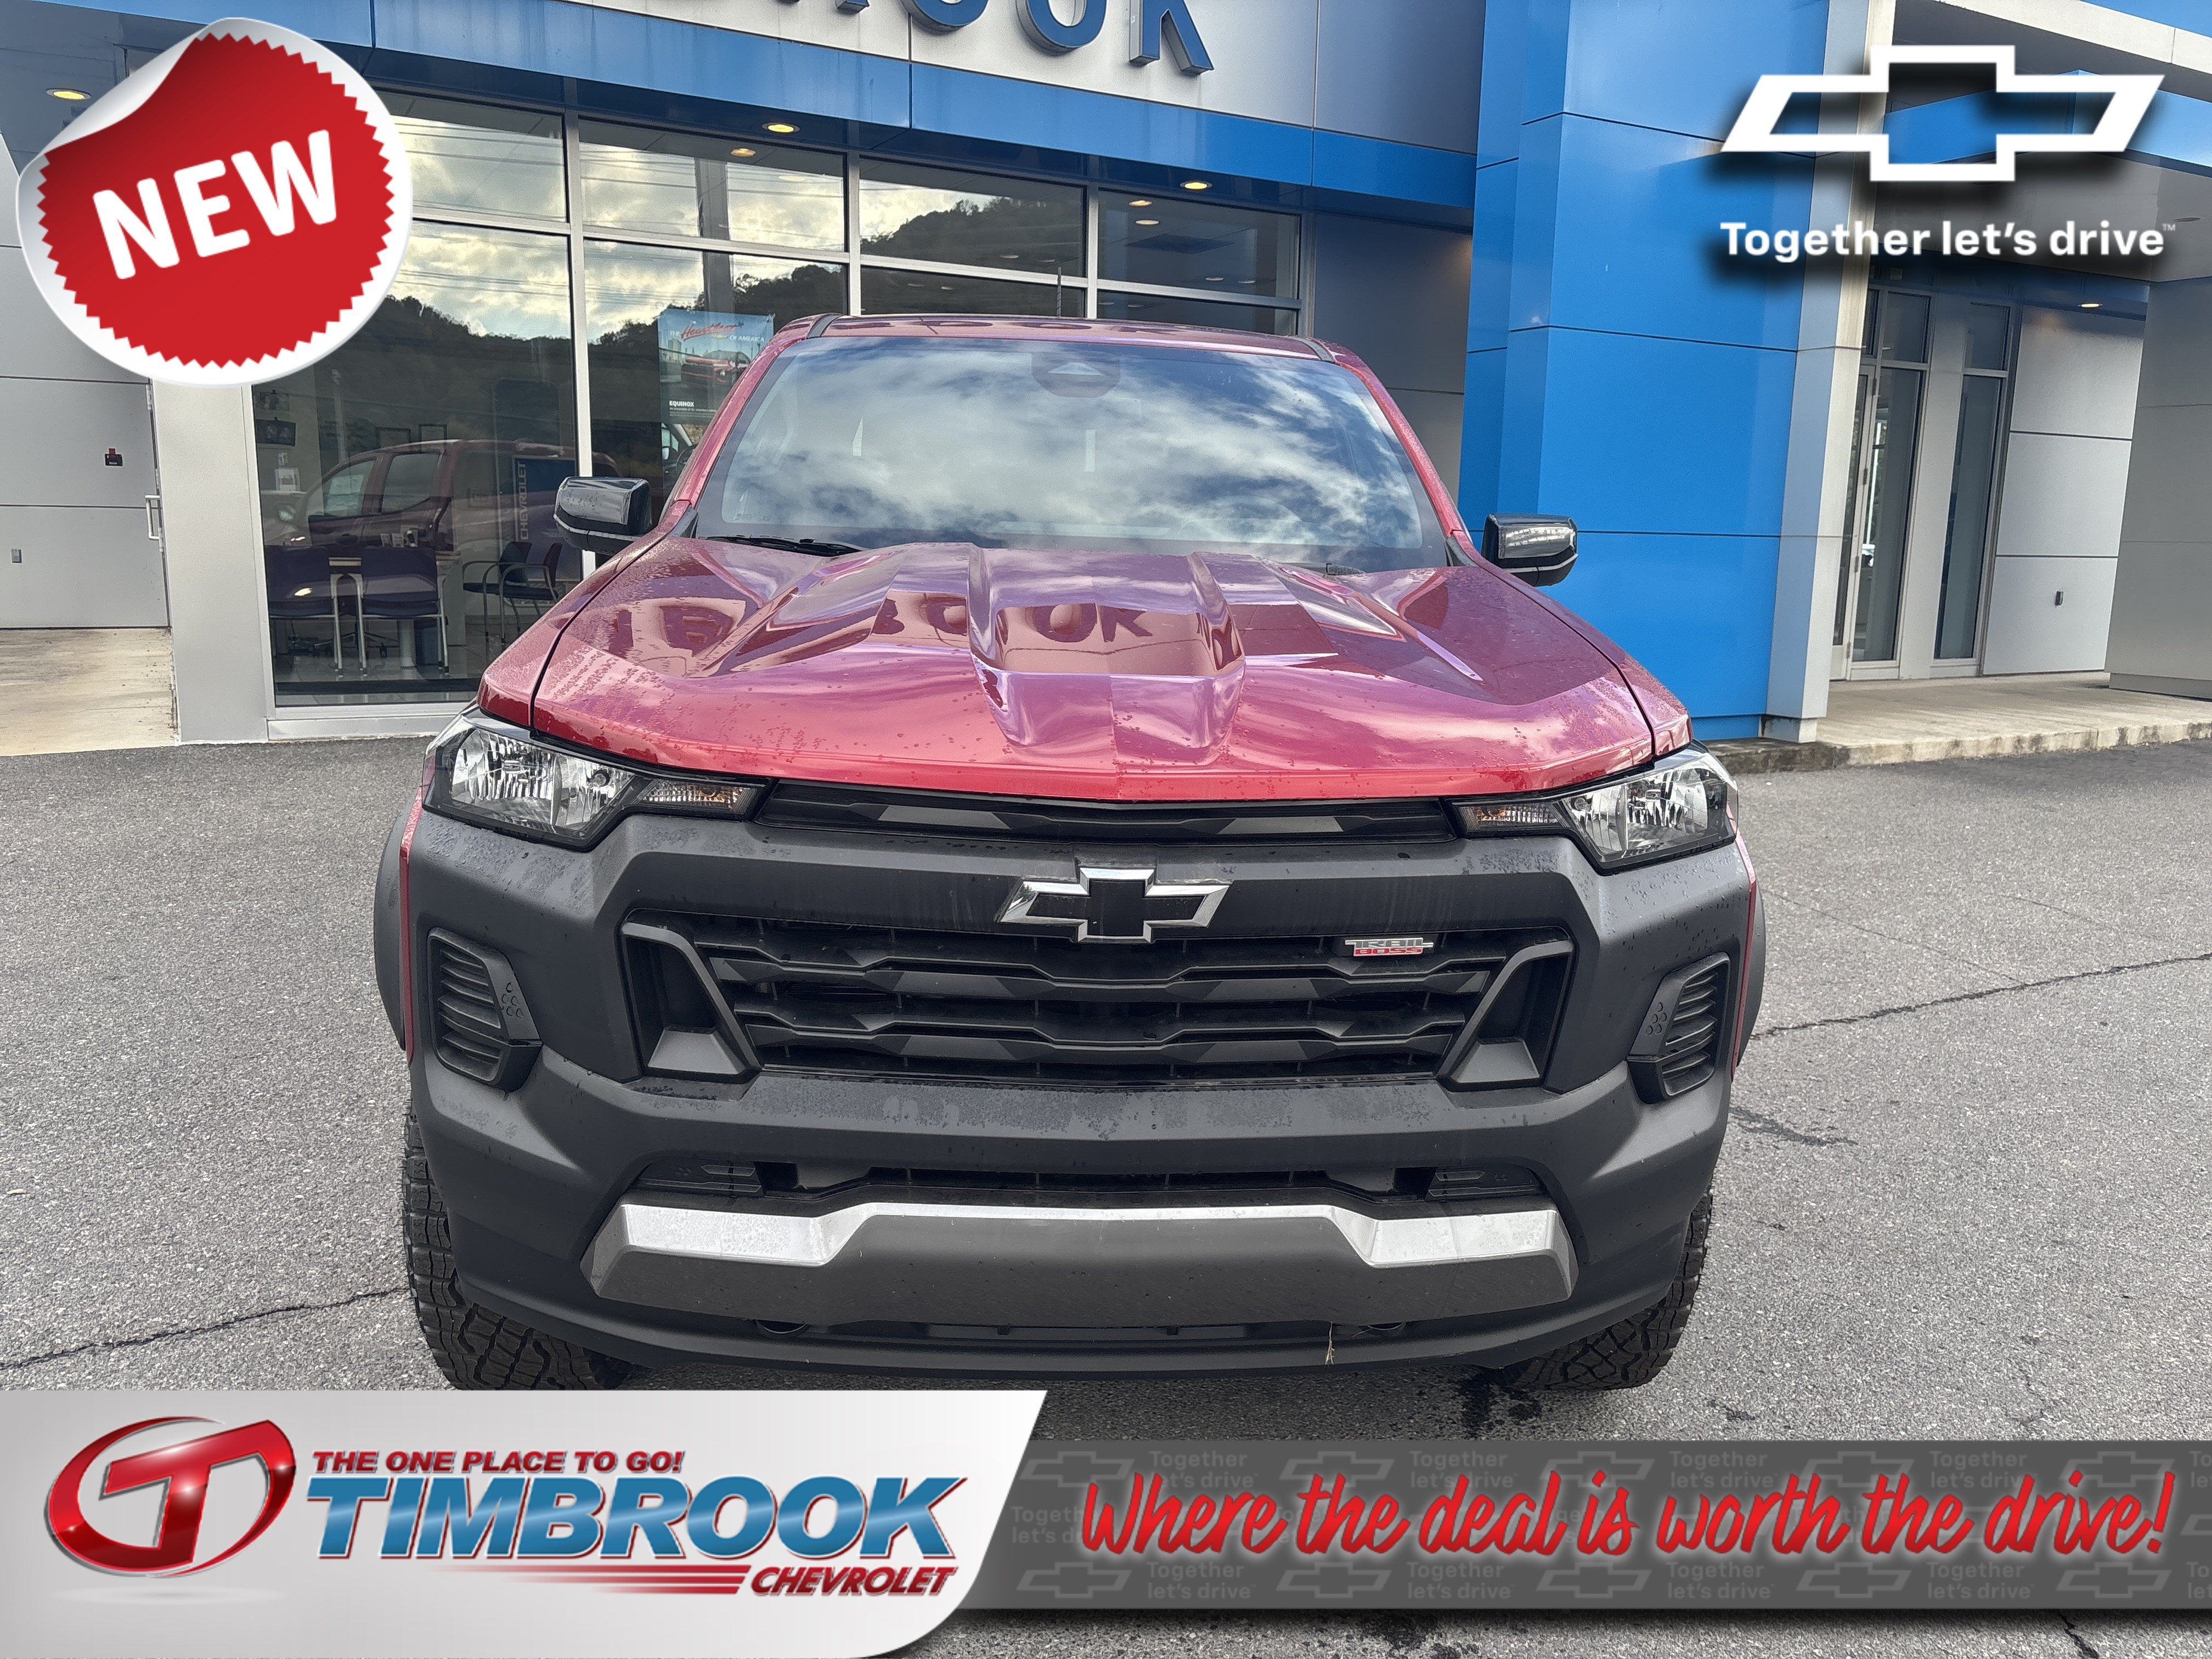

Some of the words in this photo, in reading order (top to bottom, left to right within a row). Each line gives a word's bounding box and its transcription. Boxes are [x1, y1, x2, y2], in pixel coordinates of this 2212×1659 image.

[518, 461, 529, 540] CHEVROLET
[1345, 938, 1434, 949] TRAIL
[1353, 946, 1424, 957] BOSS
